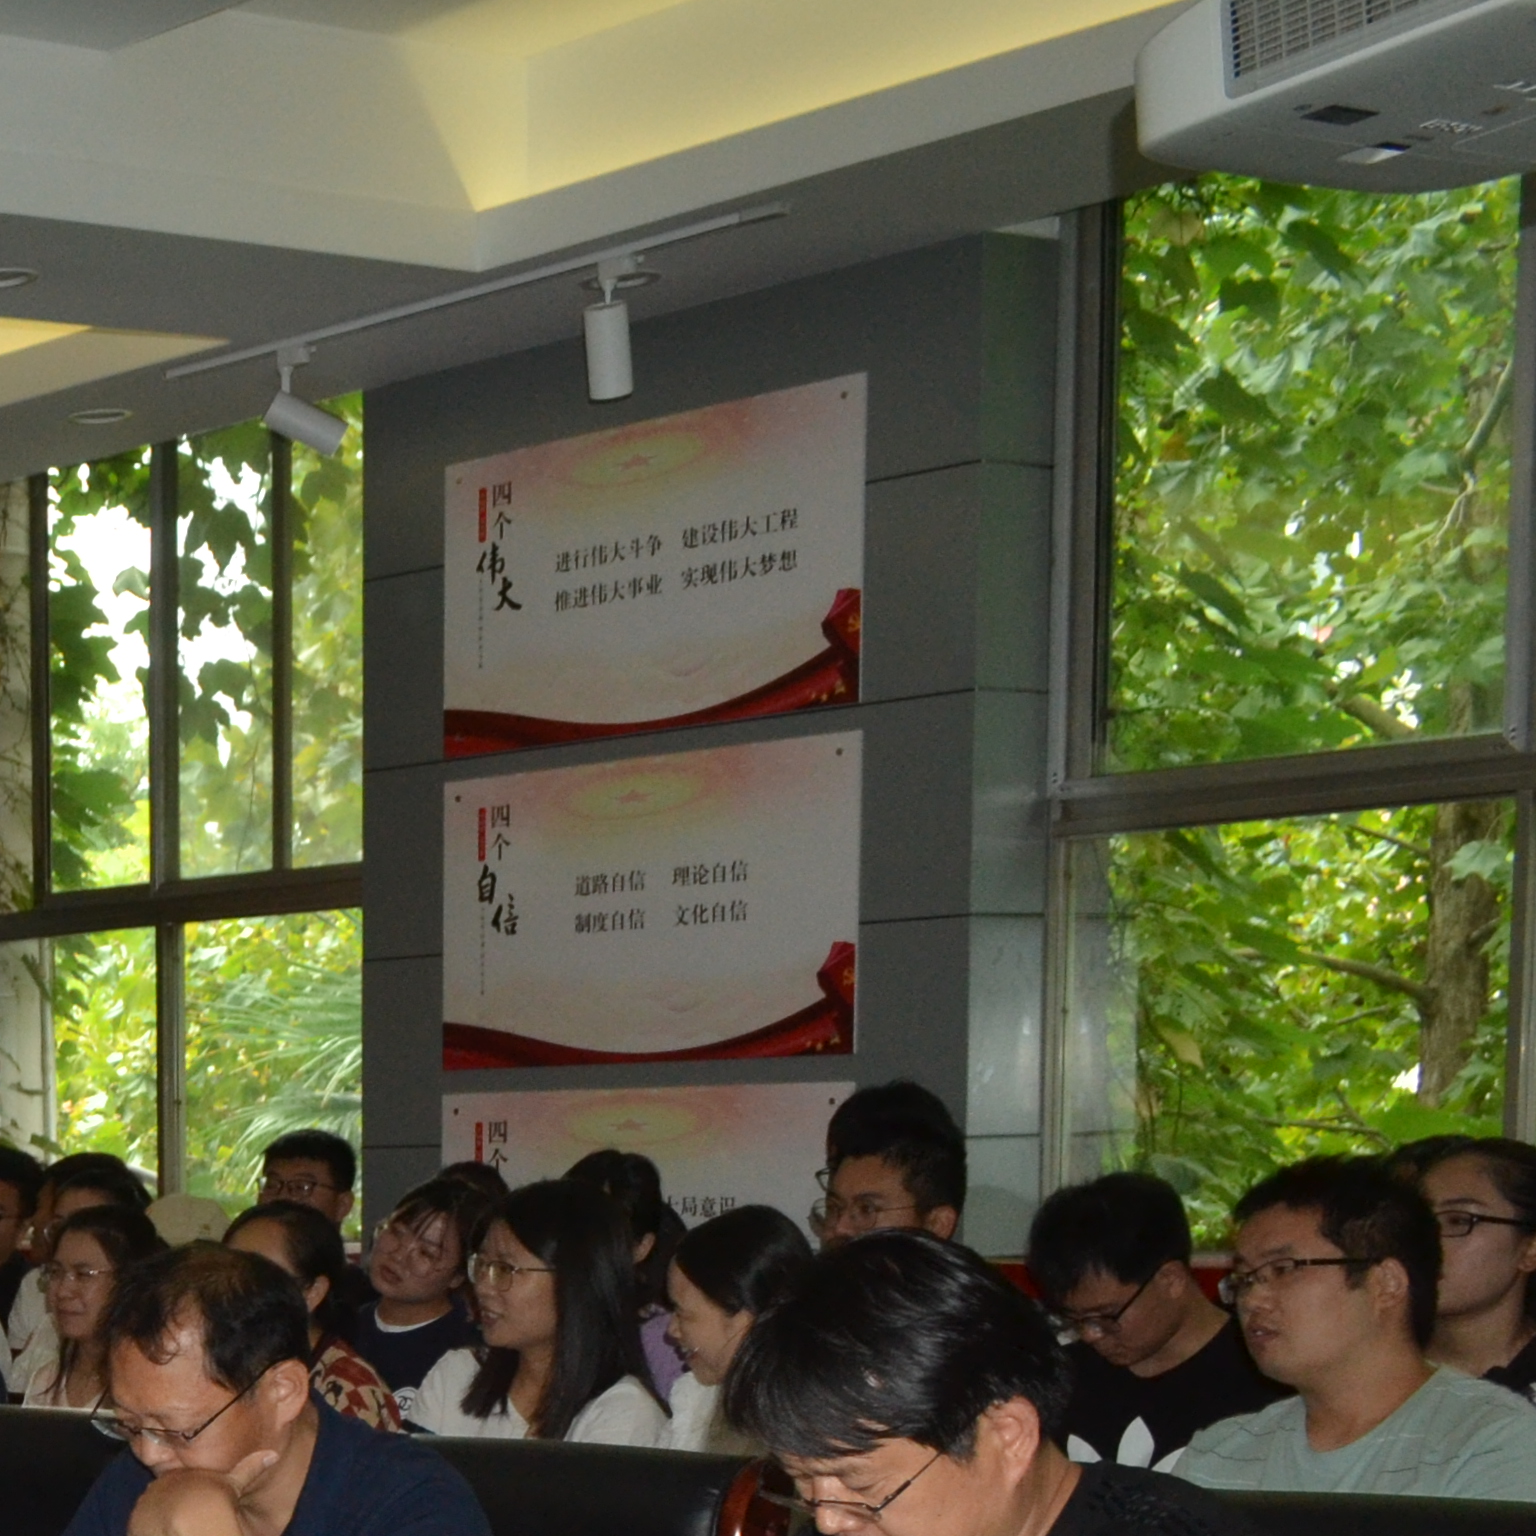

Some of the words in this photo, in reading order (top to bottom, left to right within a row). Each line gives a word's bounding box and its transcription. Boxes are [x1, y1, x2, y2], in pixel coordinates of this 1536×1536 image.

[555, 531, 662, 573] 进行伟大斗争
[682, 508, 798, 549] 建设伟大工程
[555, 572, 662, 612] 推进伟大事业
[681, 549, 798, 590] 实现伟大梦想
[575, 870, 646, 897] 道路自信
[672, 860, 748, 886] 理论自信
[575, 908, 646, 934] 制度自信
[673, 900, 748, 928] 文化自信
